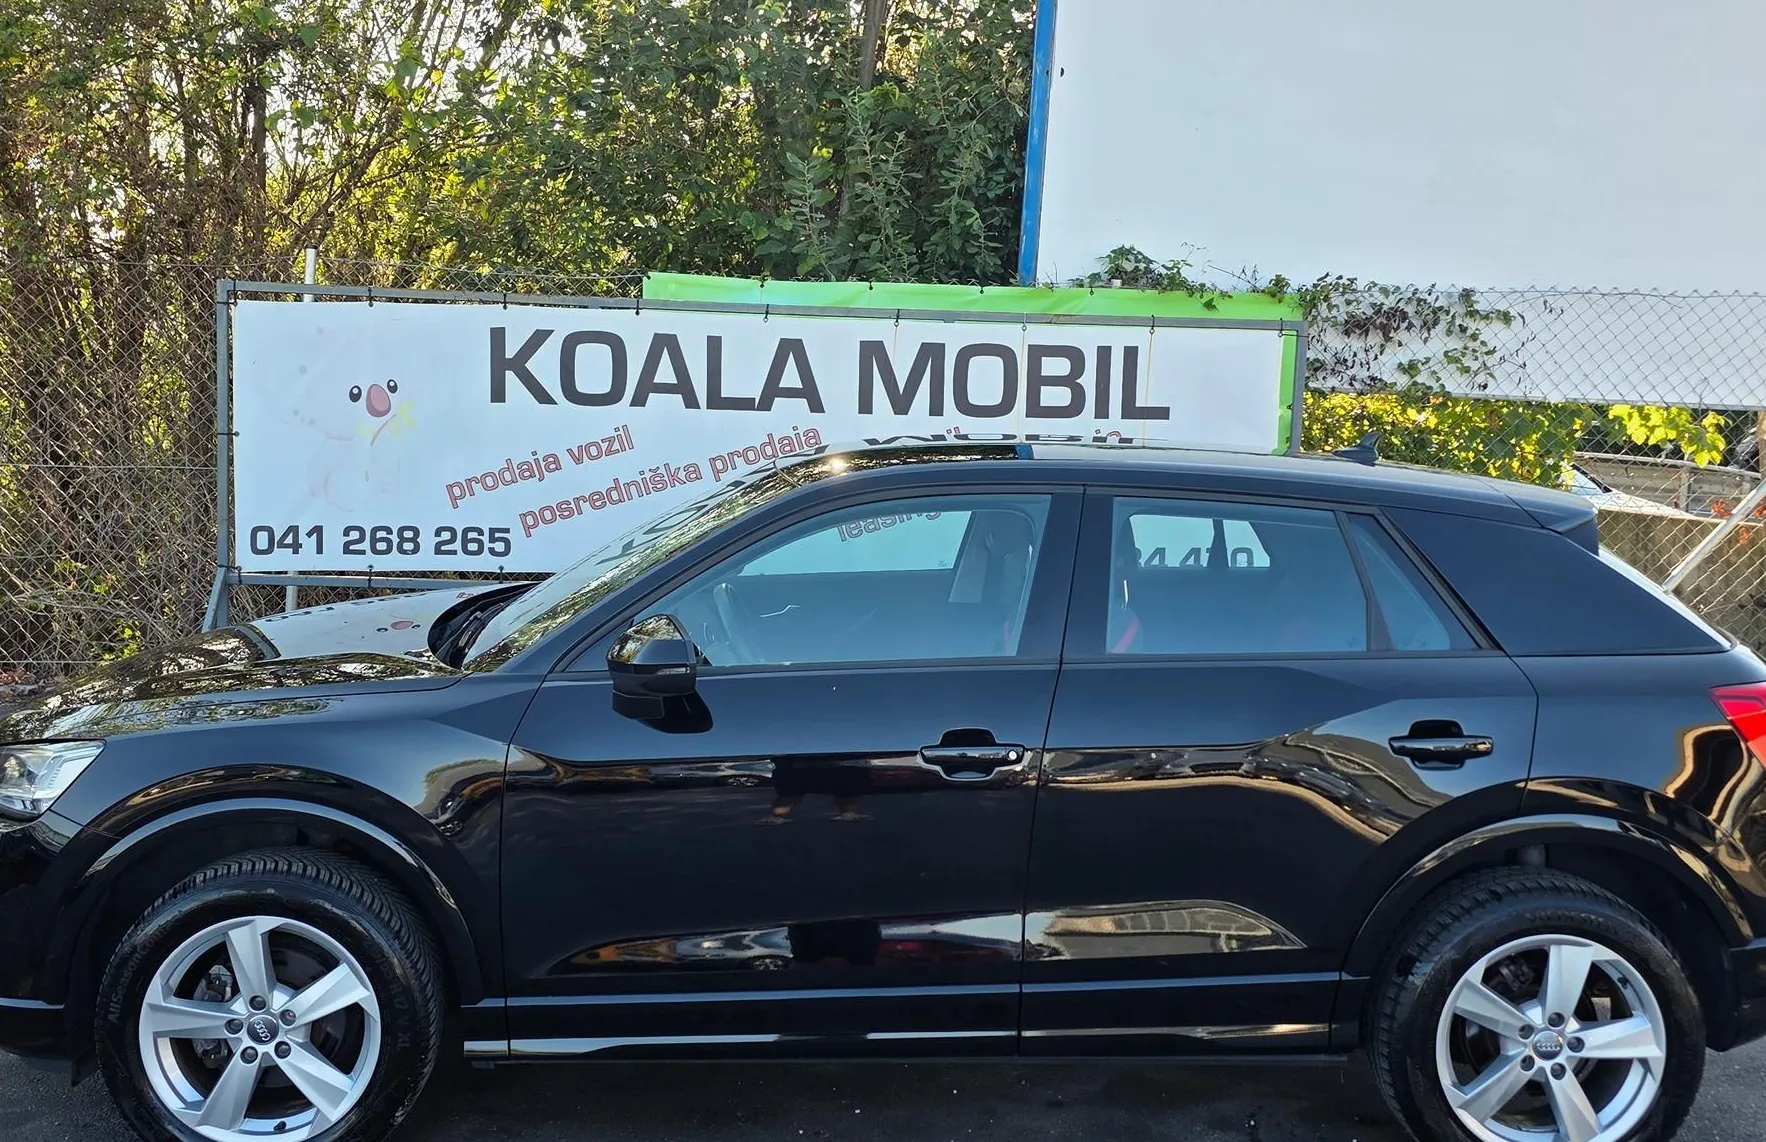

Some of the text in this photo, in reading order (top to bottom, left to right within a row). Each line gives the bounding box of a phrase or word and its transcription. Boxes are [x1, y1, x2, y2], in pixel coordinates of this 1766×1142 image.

[488, 326, 1171, 421] KOALA MOBIL
[445, 424, 635, 509] prodaja vozil
[519, 425, 823, 538] posredniška prodaja
[250, 525, 512, 558] 041 268 265
[837, 511, 942, 542] leas
